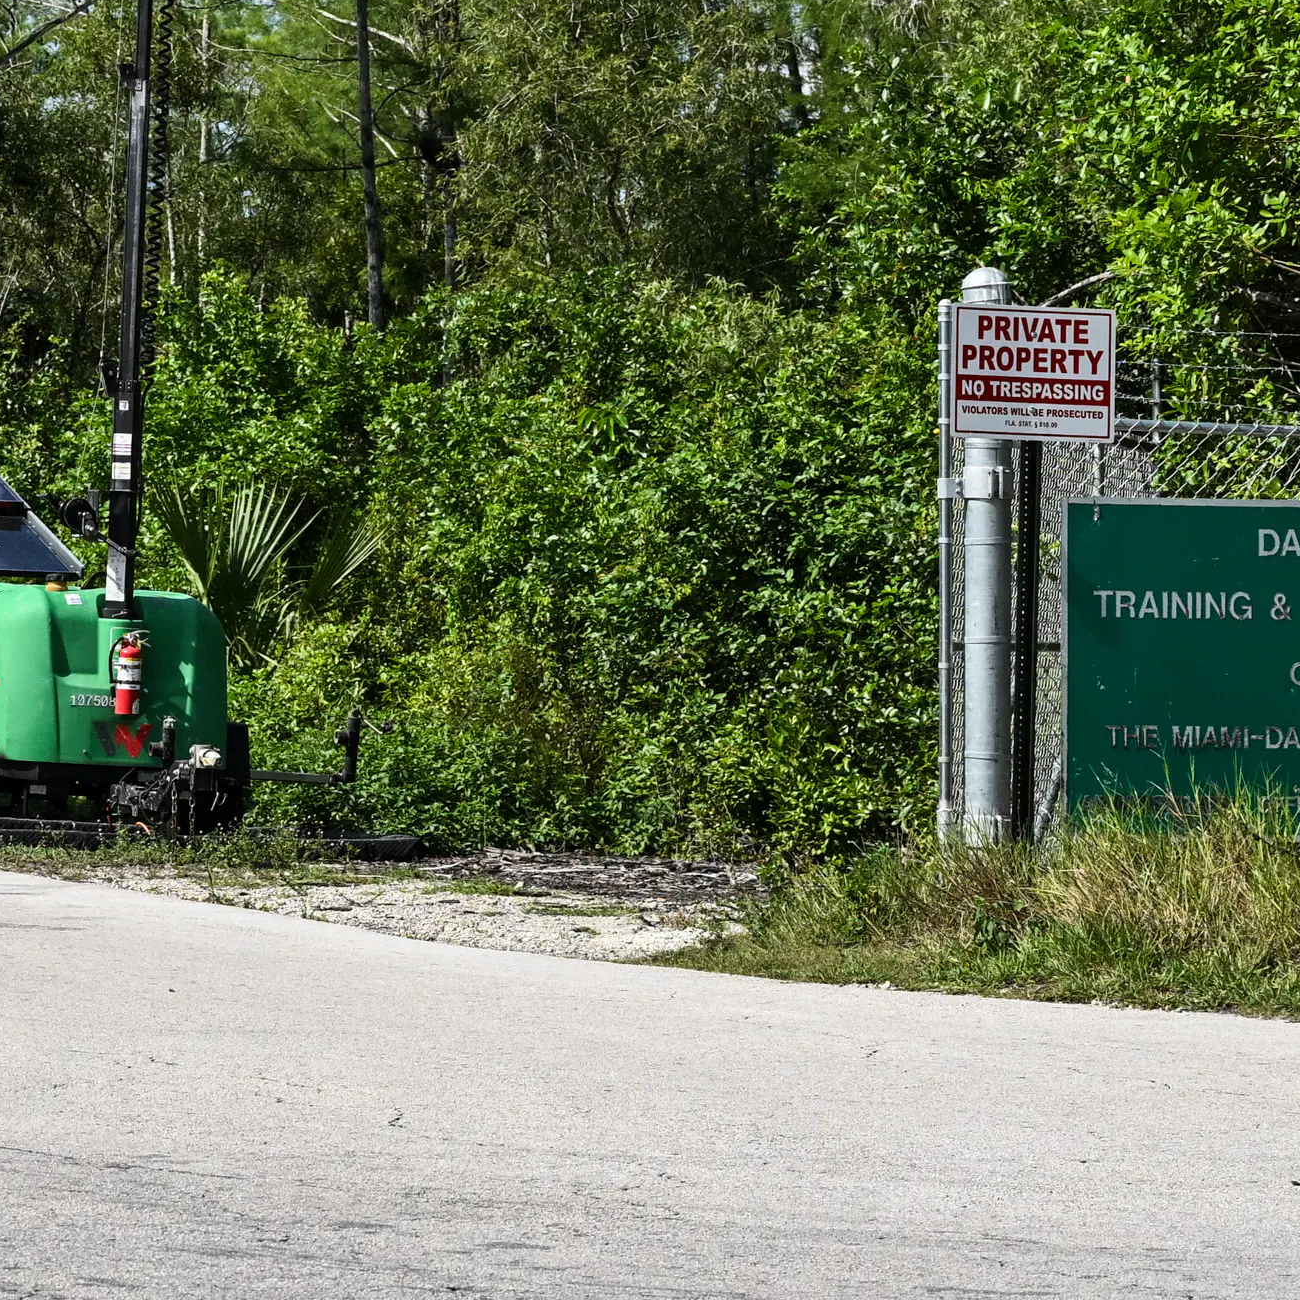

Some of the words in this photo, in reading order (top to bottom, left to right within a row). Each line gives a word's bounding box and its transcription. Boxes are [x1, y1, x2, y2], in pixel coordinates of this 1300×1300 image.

[977, 315, 1089, 345] PRIVATE
[962, 345, 1104, 375] PROPERTY
[961, 380, 985, 396] NO
[990, 381, 1104, 401] TRESPASSING
[961, 405, 1009, 416] VIOLATORS
[1010, 407, 1031, 417] WILL
[1032, 408, 1044, 417] BE
[1046, 409, 1104, 420] PROSECUTED
[1093, 590, 1253, 621] TRAINING
[1270, 592, 1292, 621] &
[1106, 724, 1159, 749] THE
